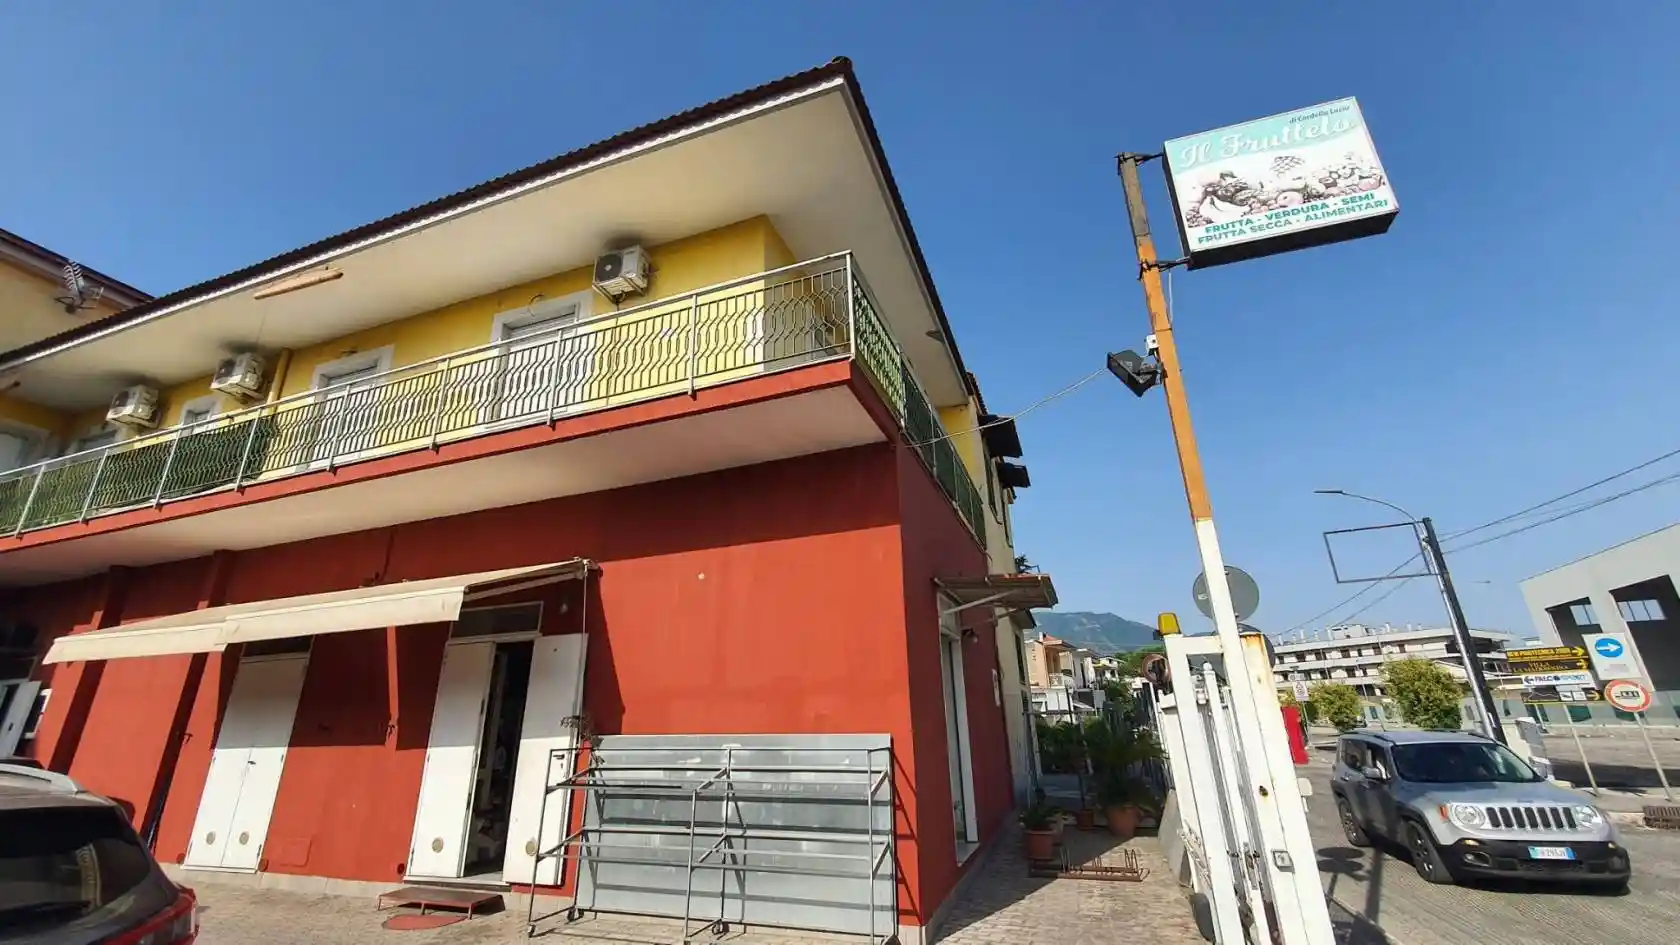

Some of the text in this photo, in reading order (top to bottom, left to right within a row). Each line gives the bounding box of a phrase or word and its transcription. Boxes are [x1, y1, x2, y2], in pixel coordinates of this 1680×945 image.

[1289, 116, 1297, 125] di
[1178, 117, 1356, 168] Il Frutteto
[1197, 227, 1247, 244] FRUTTA
[1250, 219, 1293, 233] SECCA
[1304, 199, 1388, 222] ALIMENTARI
[1204, 217, 1254, 234] FRUTTA
[1265, 202, 1330, 221] VERDURA
[1340, 193, 1375, 206] SEMI
